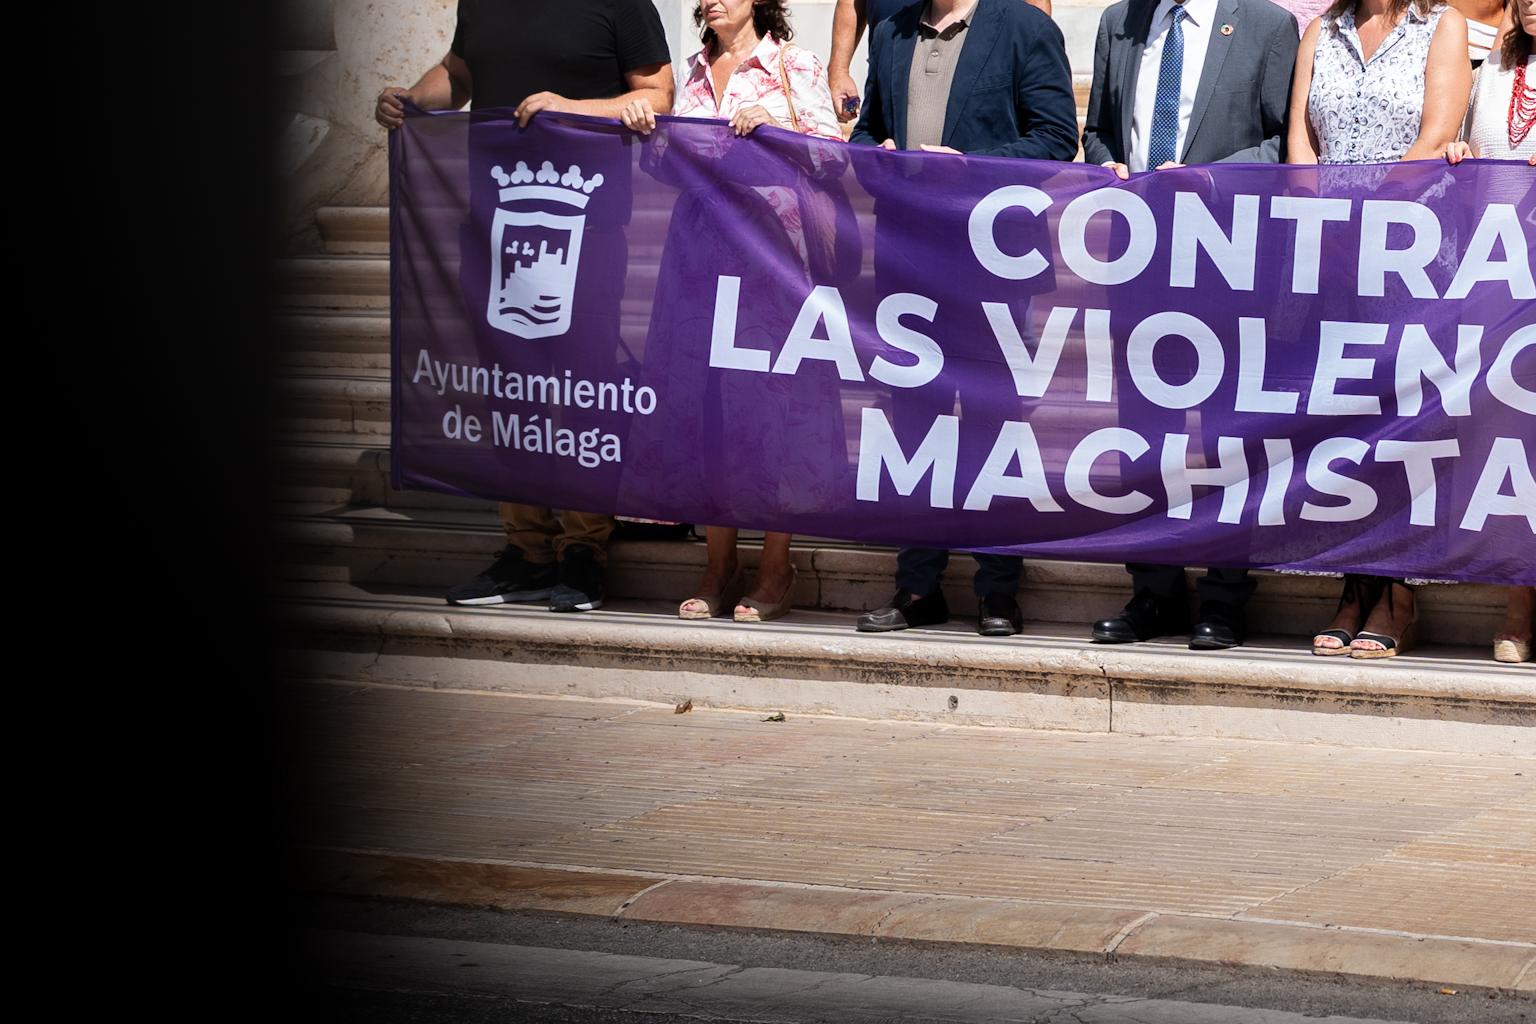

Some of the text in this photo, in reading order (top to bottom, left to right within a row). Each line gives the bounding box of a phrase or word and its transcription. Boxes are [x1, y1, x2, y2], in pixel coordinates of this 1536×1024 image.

[708, 275, 946, 389] LAS
[412, 349, 658, 416] Ayuntamiento
[442, 404, 622, 469] de Málaga
